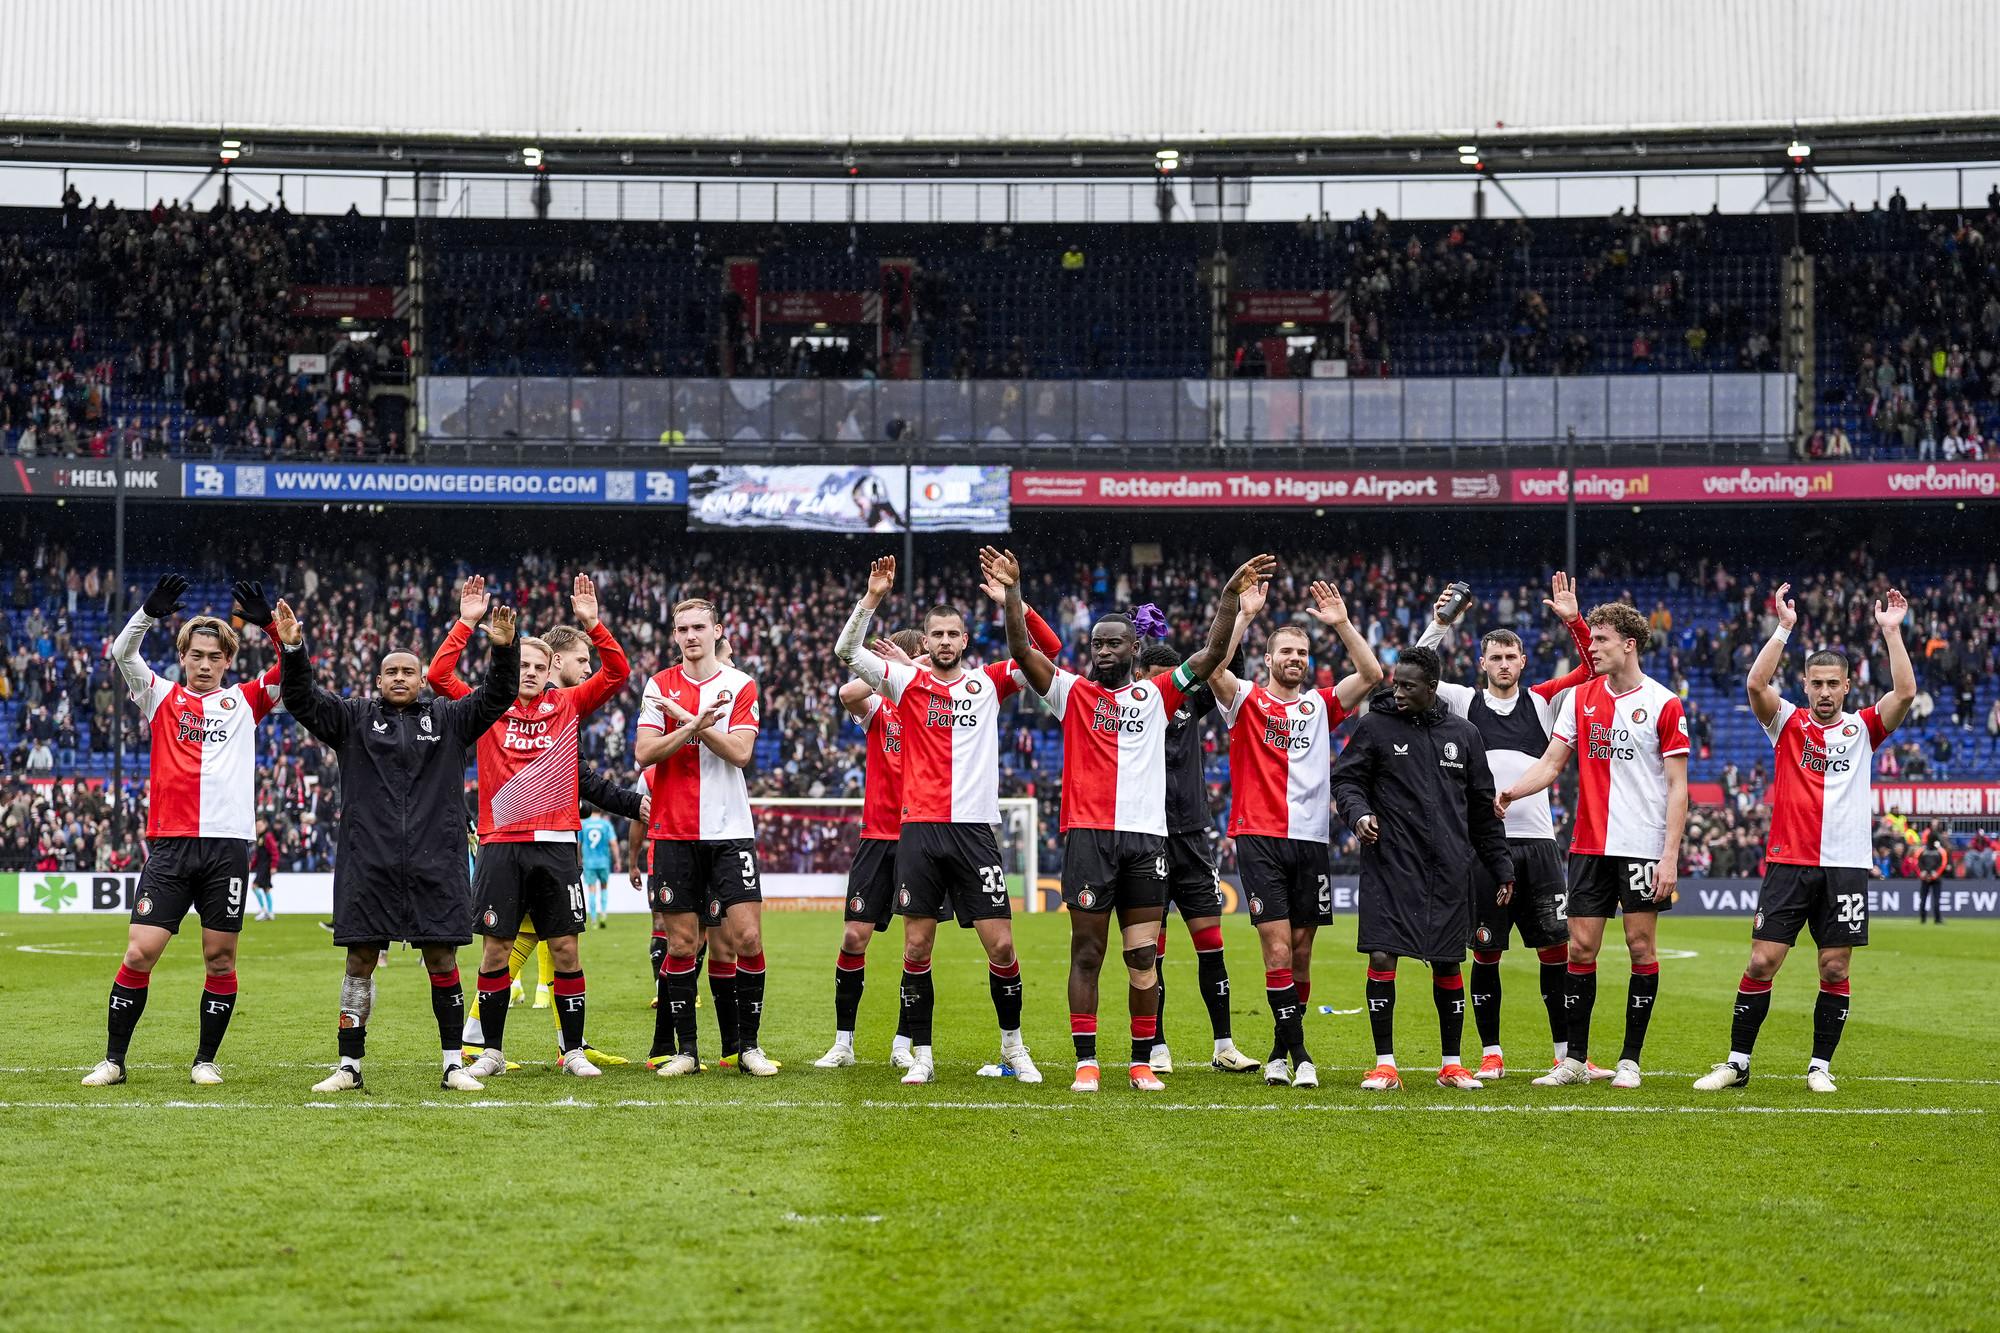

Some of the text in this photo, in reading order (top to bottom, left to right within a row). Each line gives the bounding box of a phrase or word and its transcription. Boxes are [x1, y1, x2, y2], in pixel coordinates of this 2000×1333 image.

[275, 472, 597, 493] WWW.VANDONGEDEROO.COM
[1099, 476, 1222, 497] Rotterdam
[1226, 476, 1271, 496] The
[1275, 476, 1348, 501] Hague
[1352, 476, 1438, 501] Airport
[929, 694, 972, 711] Euro
[1095, 697, 1140, 718] Euro
[507, 718, 547, 735] Euro
[926, 710, 977, 727] Parcs
[1092, 713, 1144, 733] Parcs
[1266, 715, 1307, 731] Euro
[178, 724, 227, 742] Parcs
[503, 732, 553, 749] Parcs
[1263, 729, 1310, 749] Parcs
[1589, 723, 1629, 742] Euro
[1588, 742, 1634, 760] Parcs
[1804, 736, 1846, 754] Euro
[1800, 752, 1850, 771] Parcs
[1882, 788, 1914, 814] VAN
[588, 829, 602, 849] 9
[739, 851, 755, 877] 3
[980, 865, 1006, 893] 33
[1628, 863, 1656, 891] 20
[228, 877, 243, 905] 9
[567, 883, 584, 911] 16
[1317, 874, 1331, 902] 2
[1837, 893, 1865, 922] 32
[206, 1001, 230, 1015] F
[564, 996, 585, 1012] F
[670, 1000, 687, 1013] F
[1368, 998, 1389, 1012] F
[1471, 993, 1492, 1006] F
[1563, 993, 1580, 1009] F
[1631, 994, 1653, 1008] F
[1277, 1005, 1297, 1020] F
